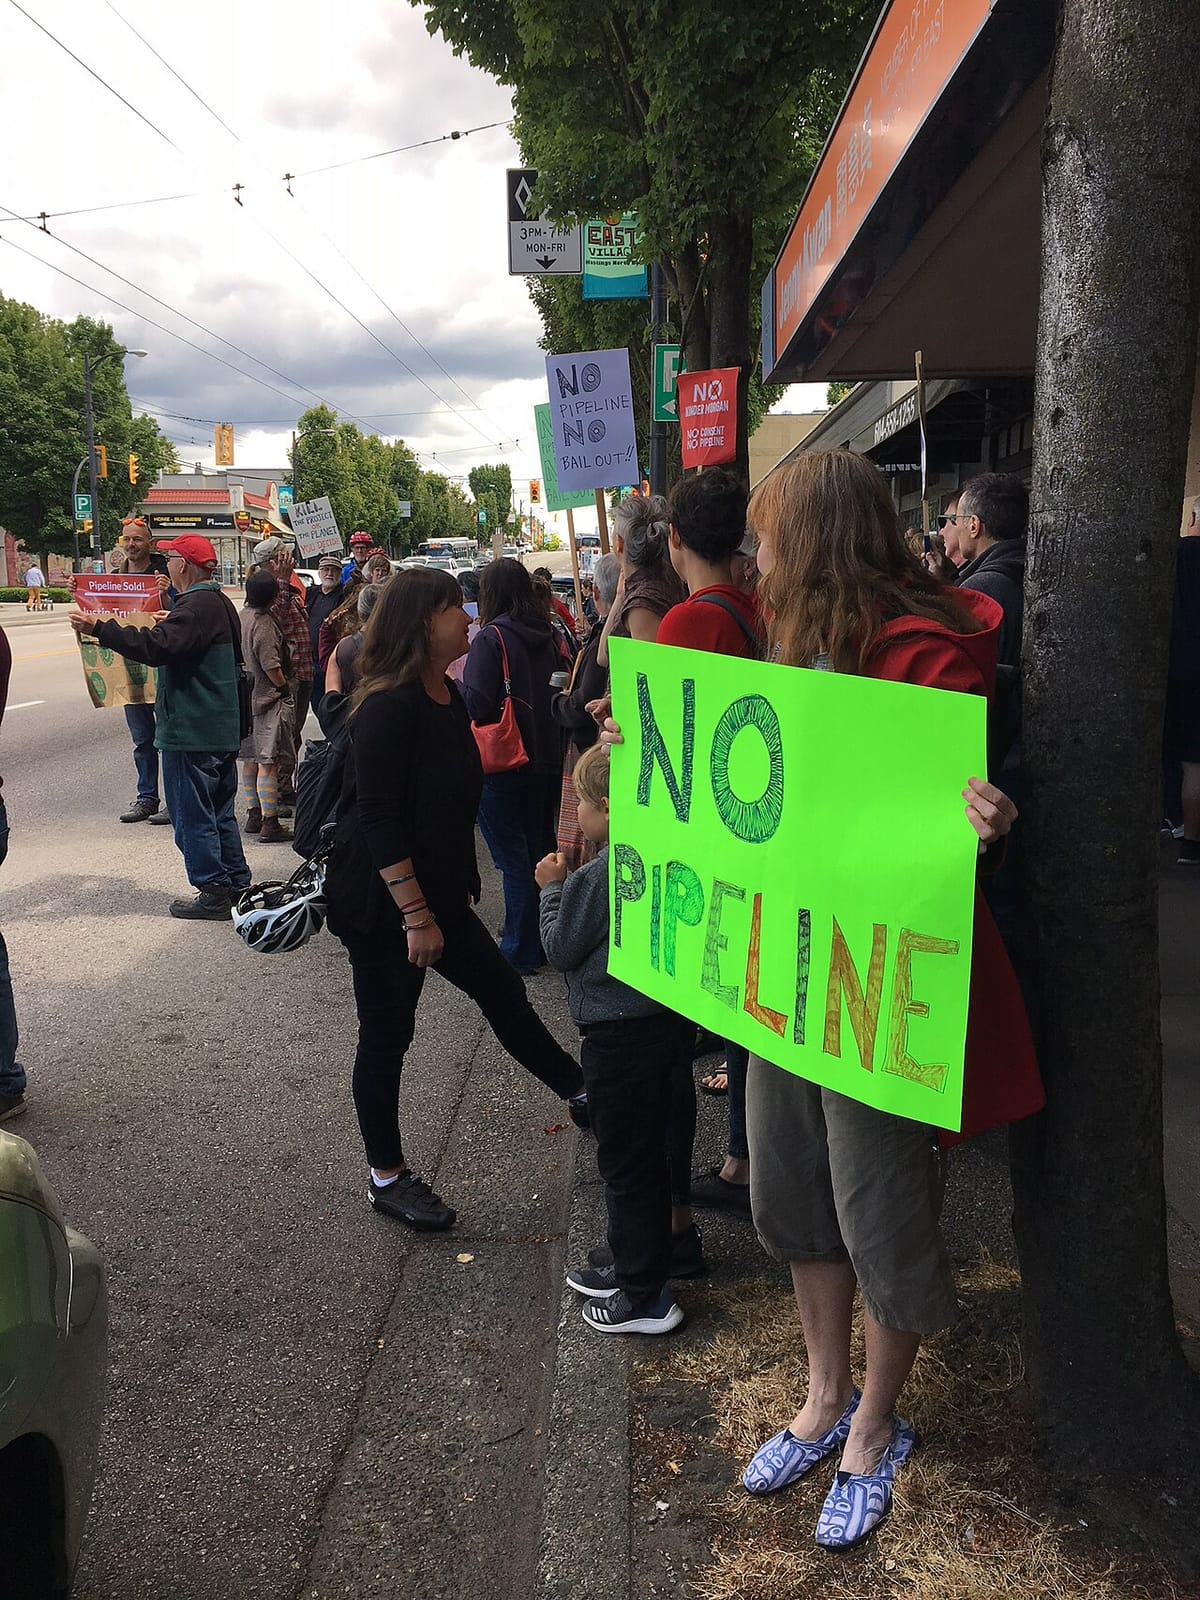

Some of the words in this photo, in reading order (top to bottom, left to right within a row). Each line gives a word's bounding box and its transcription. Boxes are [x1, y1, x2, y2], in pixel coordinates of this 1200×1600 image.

[588, 226, 637, 247] EAST
[526, 243, 567, 253] MON-FRI
[588, 246, 632, 257] VILLAG
[779, 256, 801, 330] Jenny
[803, 195, 832, 279] Kwan
[555, 362, 602, 399] NO
[692, 379, 723, 403] NO
[560, 395, 630, 418] PIPELINE
[685, 404, 704, 417] KINDER
[705, 400, 729, 415] MORGAN
[562, 419, 607, 447] NO
[687, 428, 699, 440] NO
[700, 425, 725, 438] CONSENT
[687, 439, 698, 450] NO
[699, 437, 725, 449] PIPELINE
[560, 455, 592, 471] BAIL
[595, 445, 635, 467] OUT!!
[78, 498, 89, 510] P
[295, 501, 323, 518] KILL
[306, 511, 333, 525] PROJECT
[310, 525, 337, 540] PLANET
[300, 543, 316, 555] YOU
[88, 581, 122, 591] Pipeline
[123, 581, 145, 591] Sold!
[636, 671, 785, 845] NO
[613, 843, 961, 1094] PIPELINE
